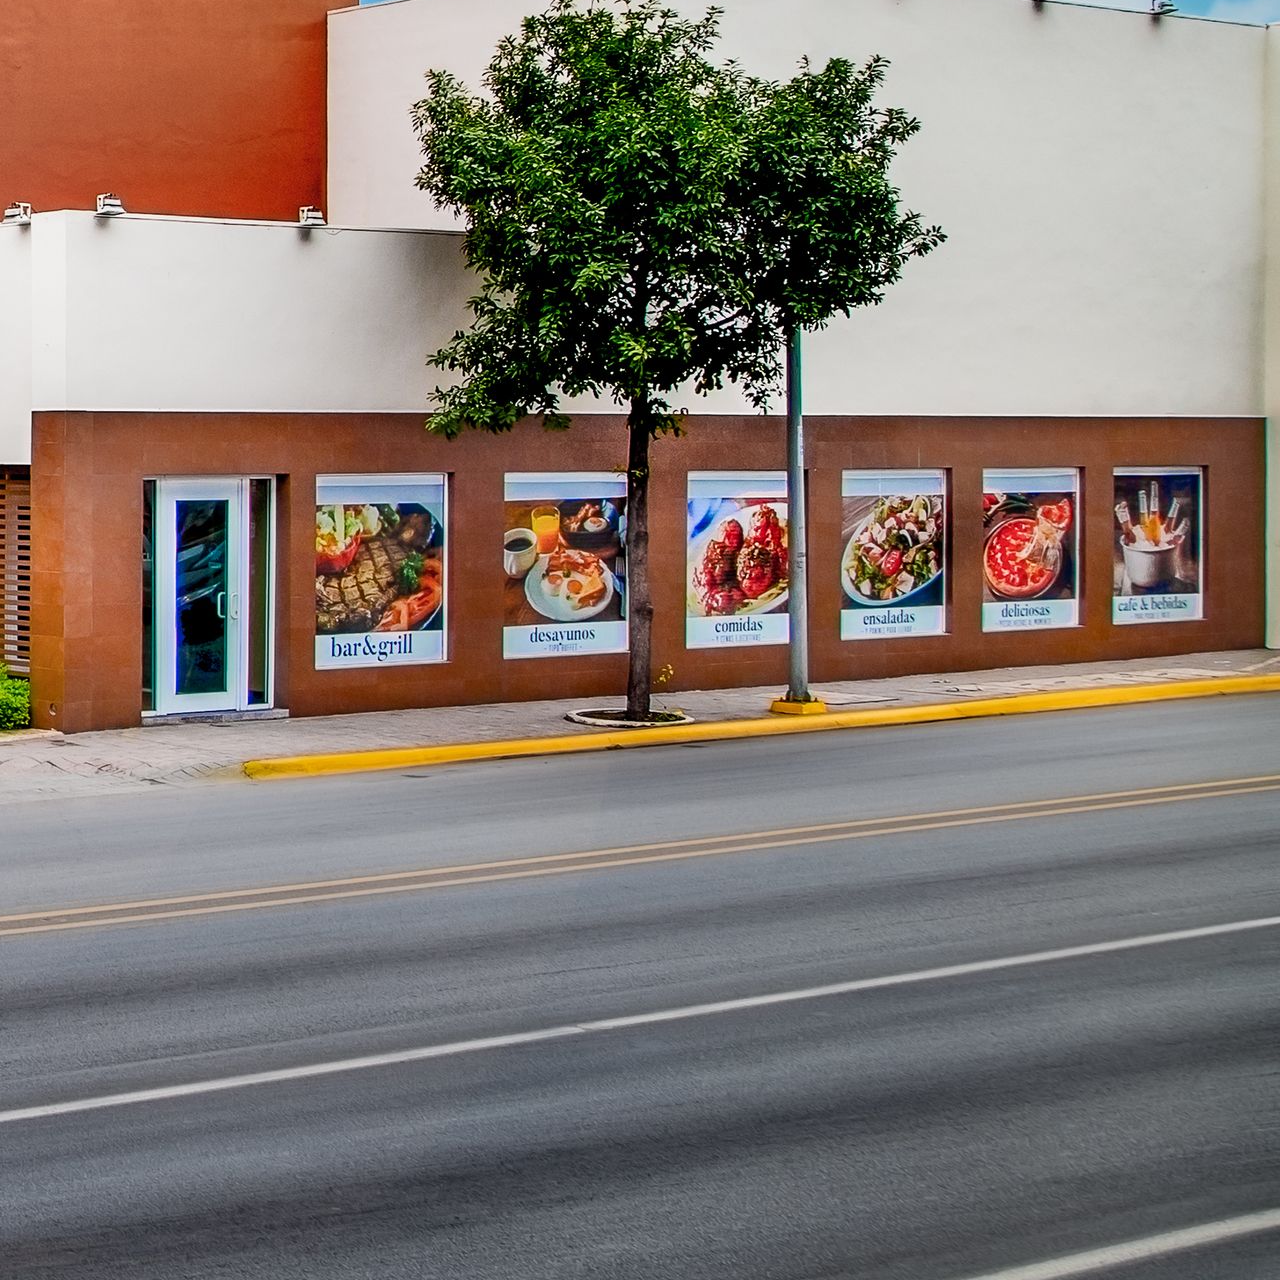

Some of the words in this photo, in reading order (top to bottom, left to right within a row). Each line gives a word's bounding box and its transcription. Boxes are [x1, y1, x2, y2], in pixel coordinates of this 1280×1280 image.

[863, 609, 916, 625] ensaladas
[1001, 603, 1051, 617] deliciosas
[714, 616, 763, 632] comidas
[530, 627, 596, 645] desayunos
[331, 633, 413, 661] bar&grill
